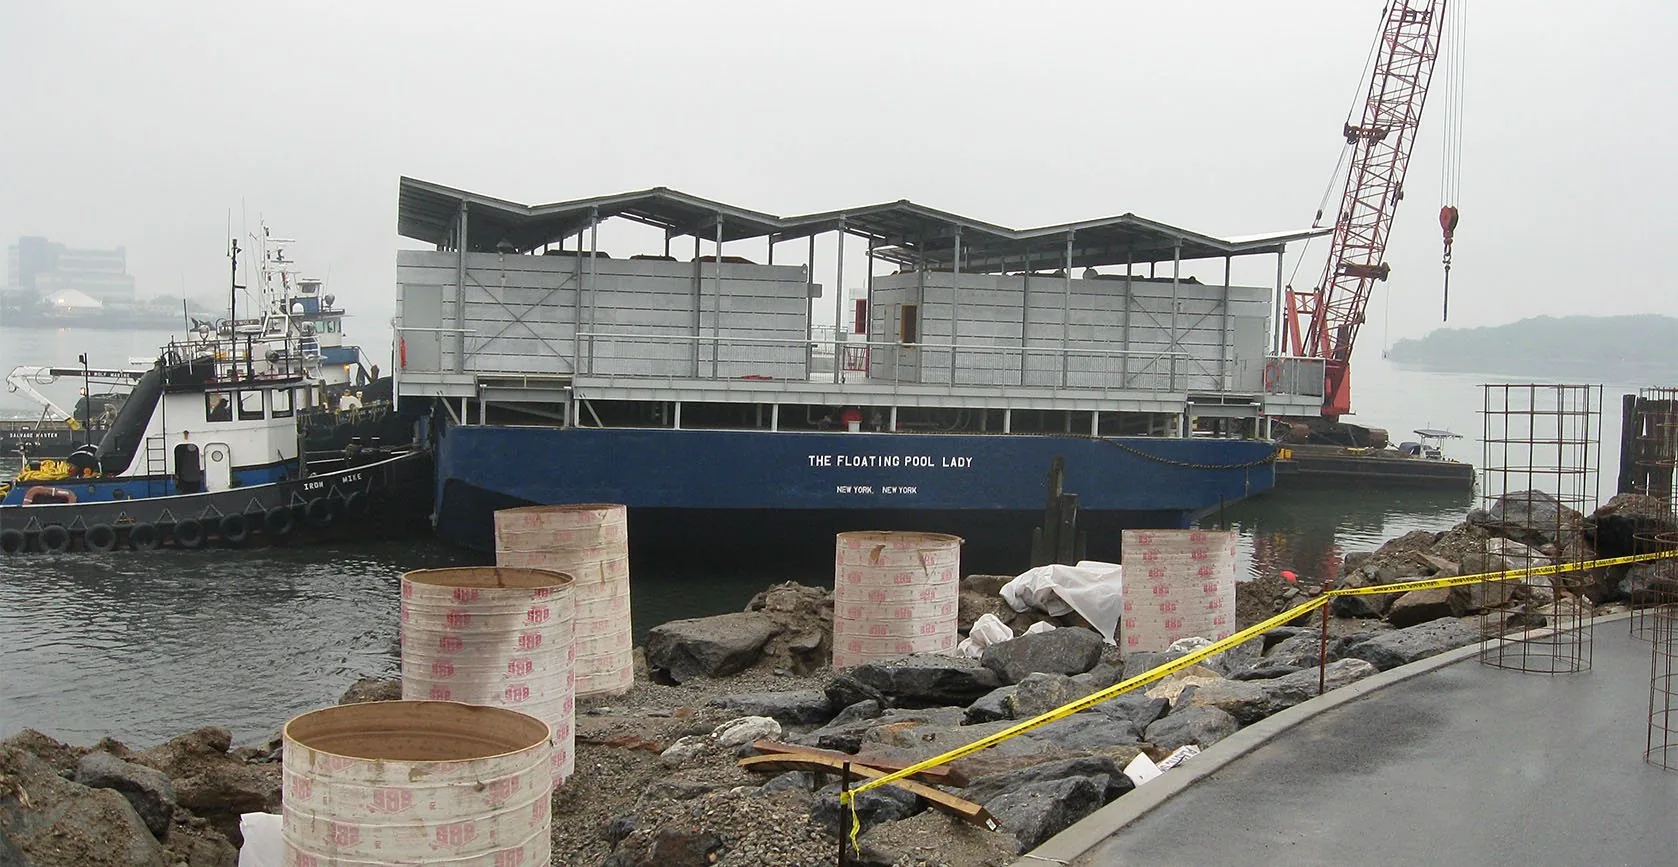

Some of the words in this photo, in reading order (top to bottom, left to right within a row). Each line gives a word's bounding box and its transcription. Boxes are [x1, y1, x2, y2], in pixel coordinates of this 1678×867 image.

[808, 455, 832, 467] THE
[836, 455, 900, 467] FLOATING
[904, 456, 935, 467] POOL
[942, 456, 973, 468] LADY
[303, 481, 324, 491] IRON
[342, 473, 362, 484] MIKE
[836, 486, 852, 494] NEW
[882, 486, 897, 494] NEW
[898, 486, 917, 494] YORK
